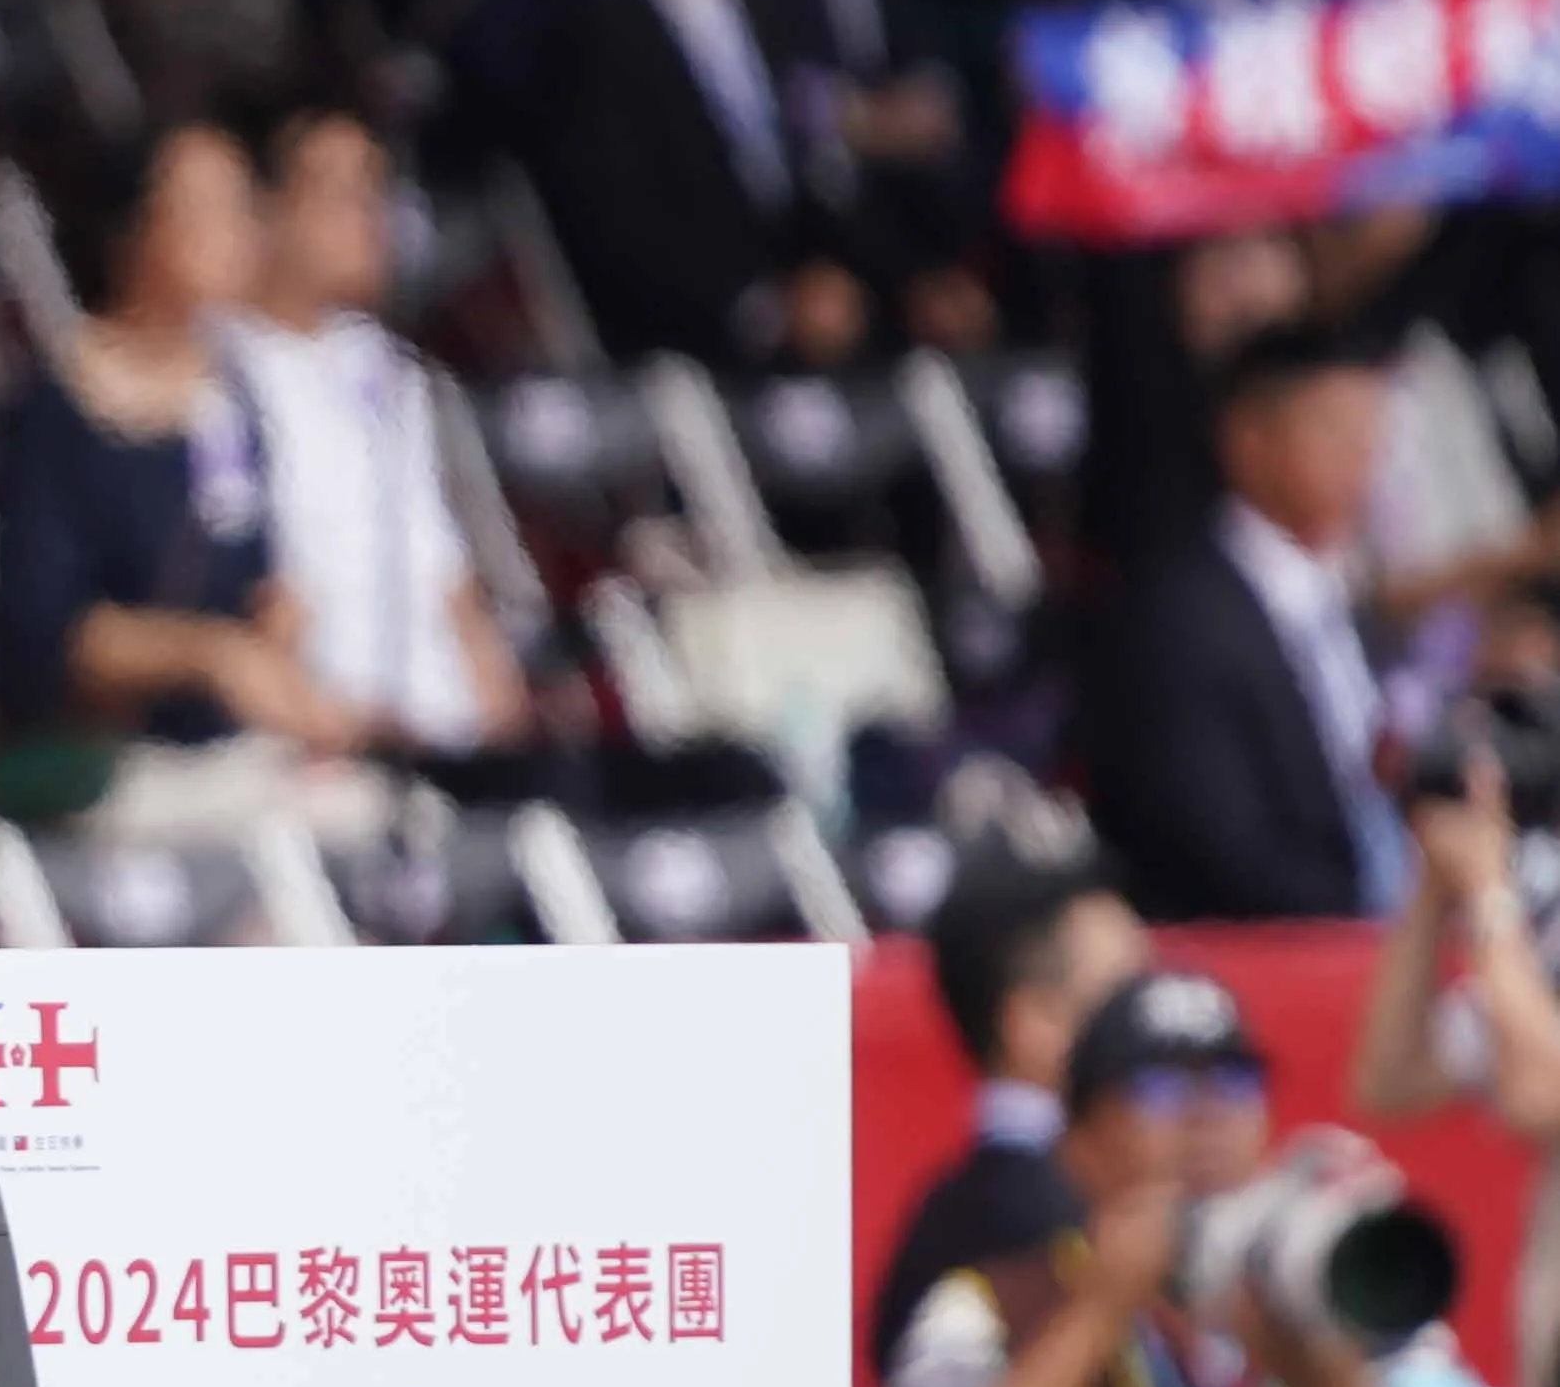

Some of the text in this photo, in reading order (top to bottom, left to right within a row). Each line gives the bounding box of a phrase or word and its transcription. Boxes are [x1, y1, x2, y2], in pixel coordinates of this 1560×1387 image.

[27, 1242, 726, 1349] 2024巴黎奧運代表團
